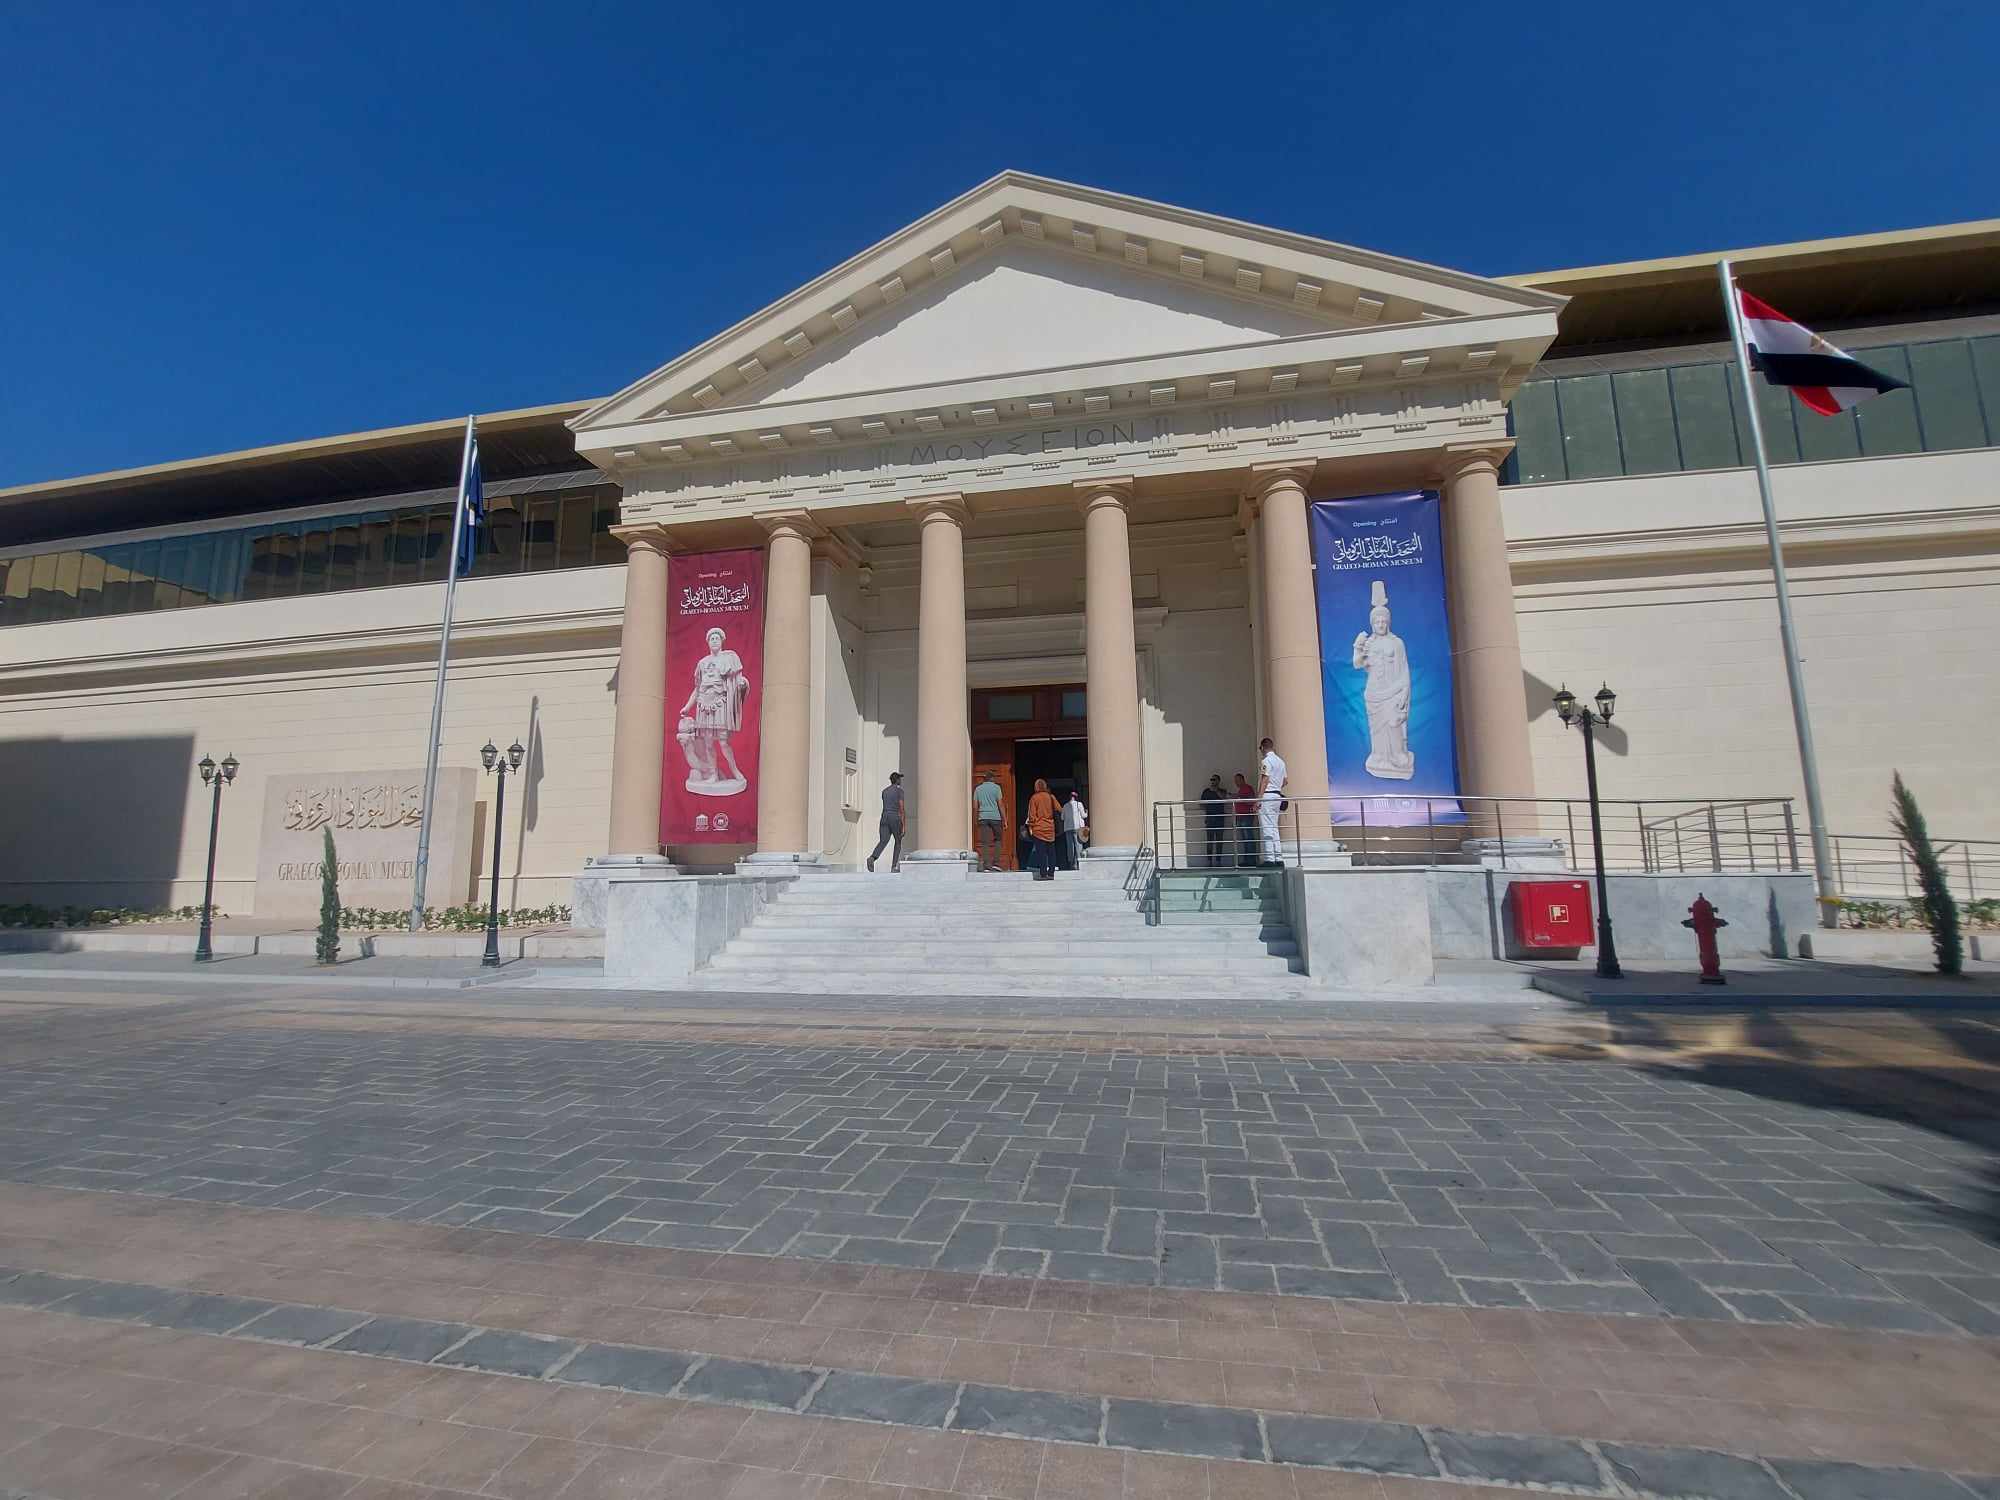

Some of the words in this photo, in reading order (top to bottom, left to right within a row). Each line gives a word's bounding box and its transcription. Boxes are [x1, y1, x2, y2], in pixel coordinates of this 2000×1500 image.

[1333, 561, 1389, 570] GRAECO-ROMAN
[1390, 558, 1423, 566] MUSEUM
[725, 604, 749, 612] MUSEUM
